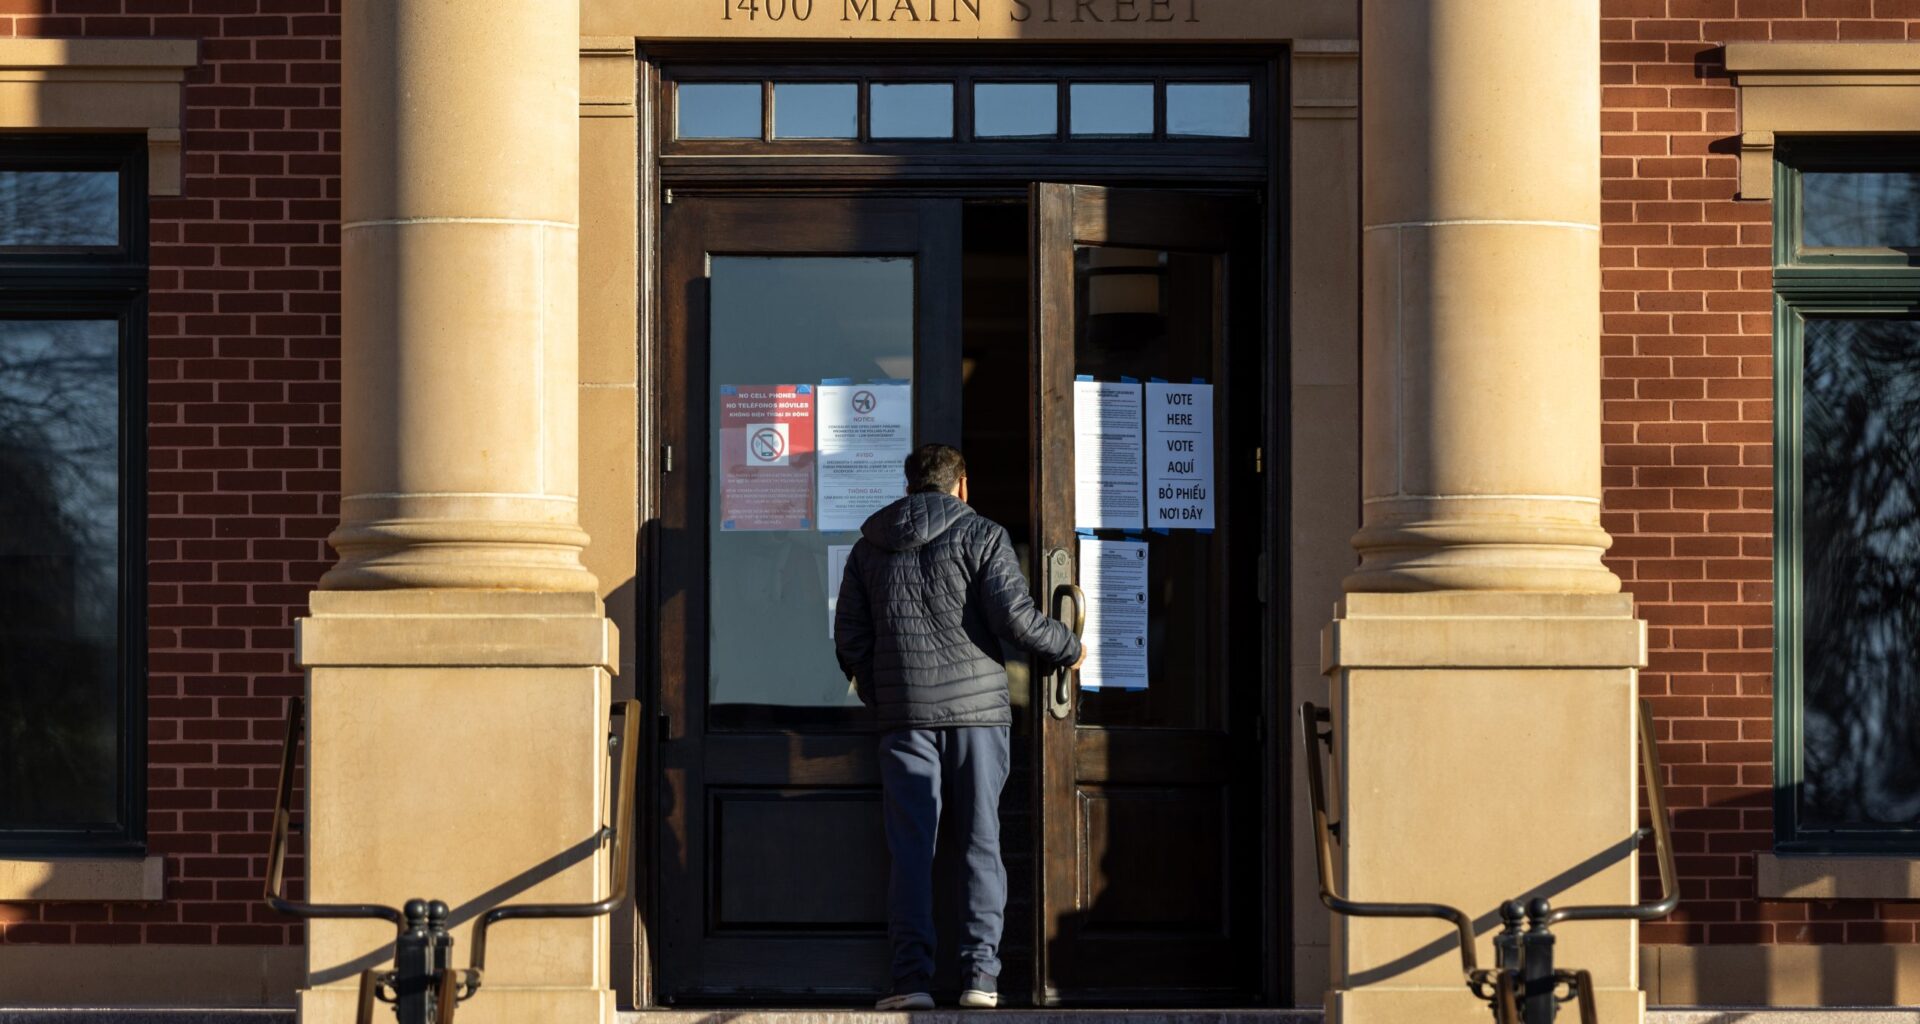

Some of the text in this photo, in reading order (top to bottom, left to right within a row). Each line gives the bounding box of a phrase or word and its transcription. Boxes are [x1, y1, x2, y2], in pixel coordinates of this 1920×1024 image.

[721, 0, 1200, 22] 1400 MAIN STREET
[1166, 393, 1193, 405] VOTE
[1167, 413, 1193, 425] HERE
[1167, 440, 1194, 451] VOTE
[1168, 459, 1194, 474] AQUÍ
[1158, 484, 1173, 499] BỎ
[1176, 484, 1206, 500] PHIẾU
[1159, 505, 1203, 520] NƠI ĐÂY
